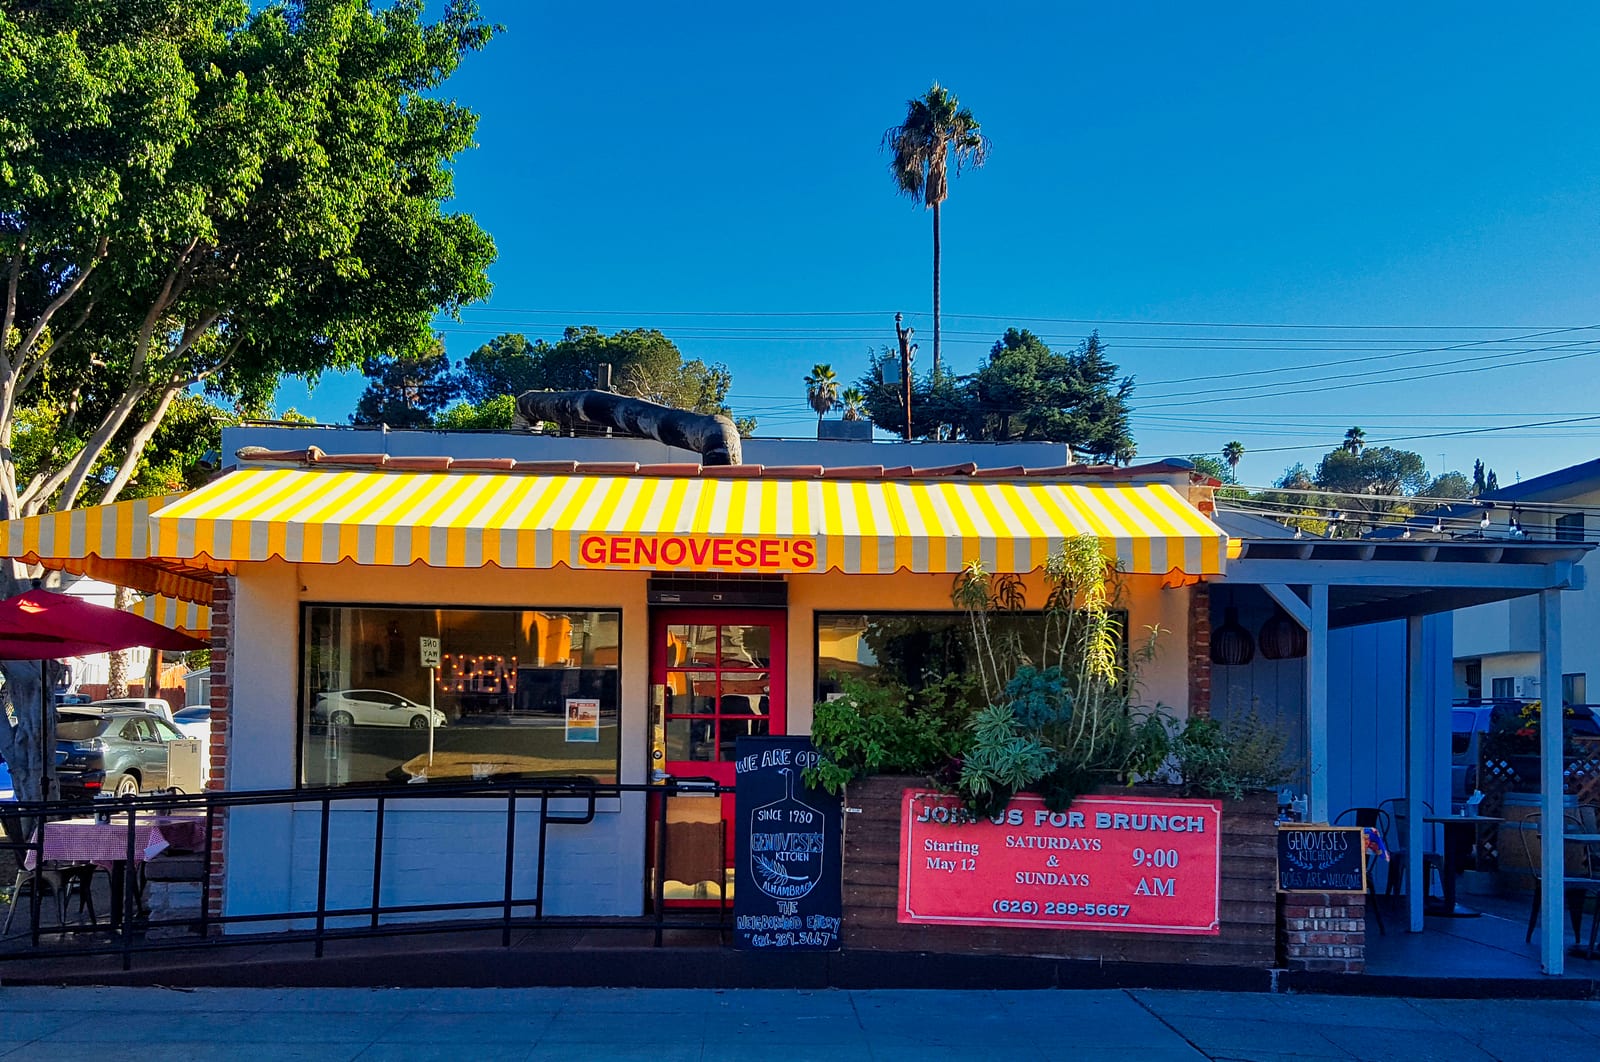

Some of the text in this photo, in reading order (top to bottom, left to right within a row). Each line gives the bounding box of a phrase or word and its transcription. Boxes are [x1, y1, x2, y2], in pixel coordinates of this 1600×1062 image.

[581, 536, 815, 568] GENOVESE'S
[435, 653, 518, 694] OPEN
[736, 754, 758, 773] WE
[761, 749, 791, 767] ARE
[757, 808, 813, 824] SINCE 1980
[1034, 810, 1085, 827] FOR
[1095, 812, 1204, 832] BRUNCH
[924, 839, 979, 856] Starting
[1005, 835, 1102, 851] SATURDAYS
[775, 851, 809, 862] KITCHEN
[926, 857, 976, 872] May 12
[1046, 855, 1060, 867] &
[1131, 848, 1179, 868] 9:00
[1015, 871, 1089, 887] SUNDAYS
[1133, 877, 1176, 897] AM
[776, 901, 798, 915] THE
[992, 900, 1130, 917] (626) 289-5667
